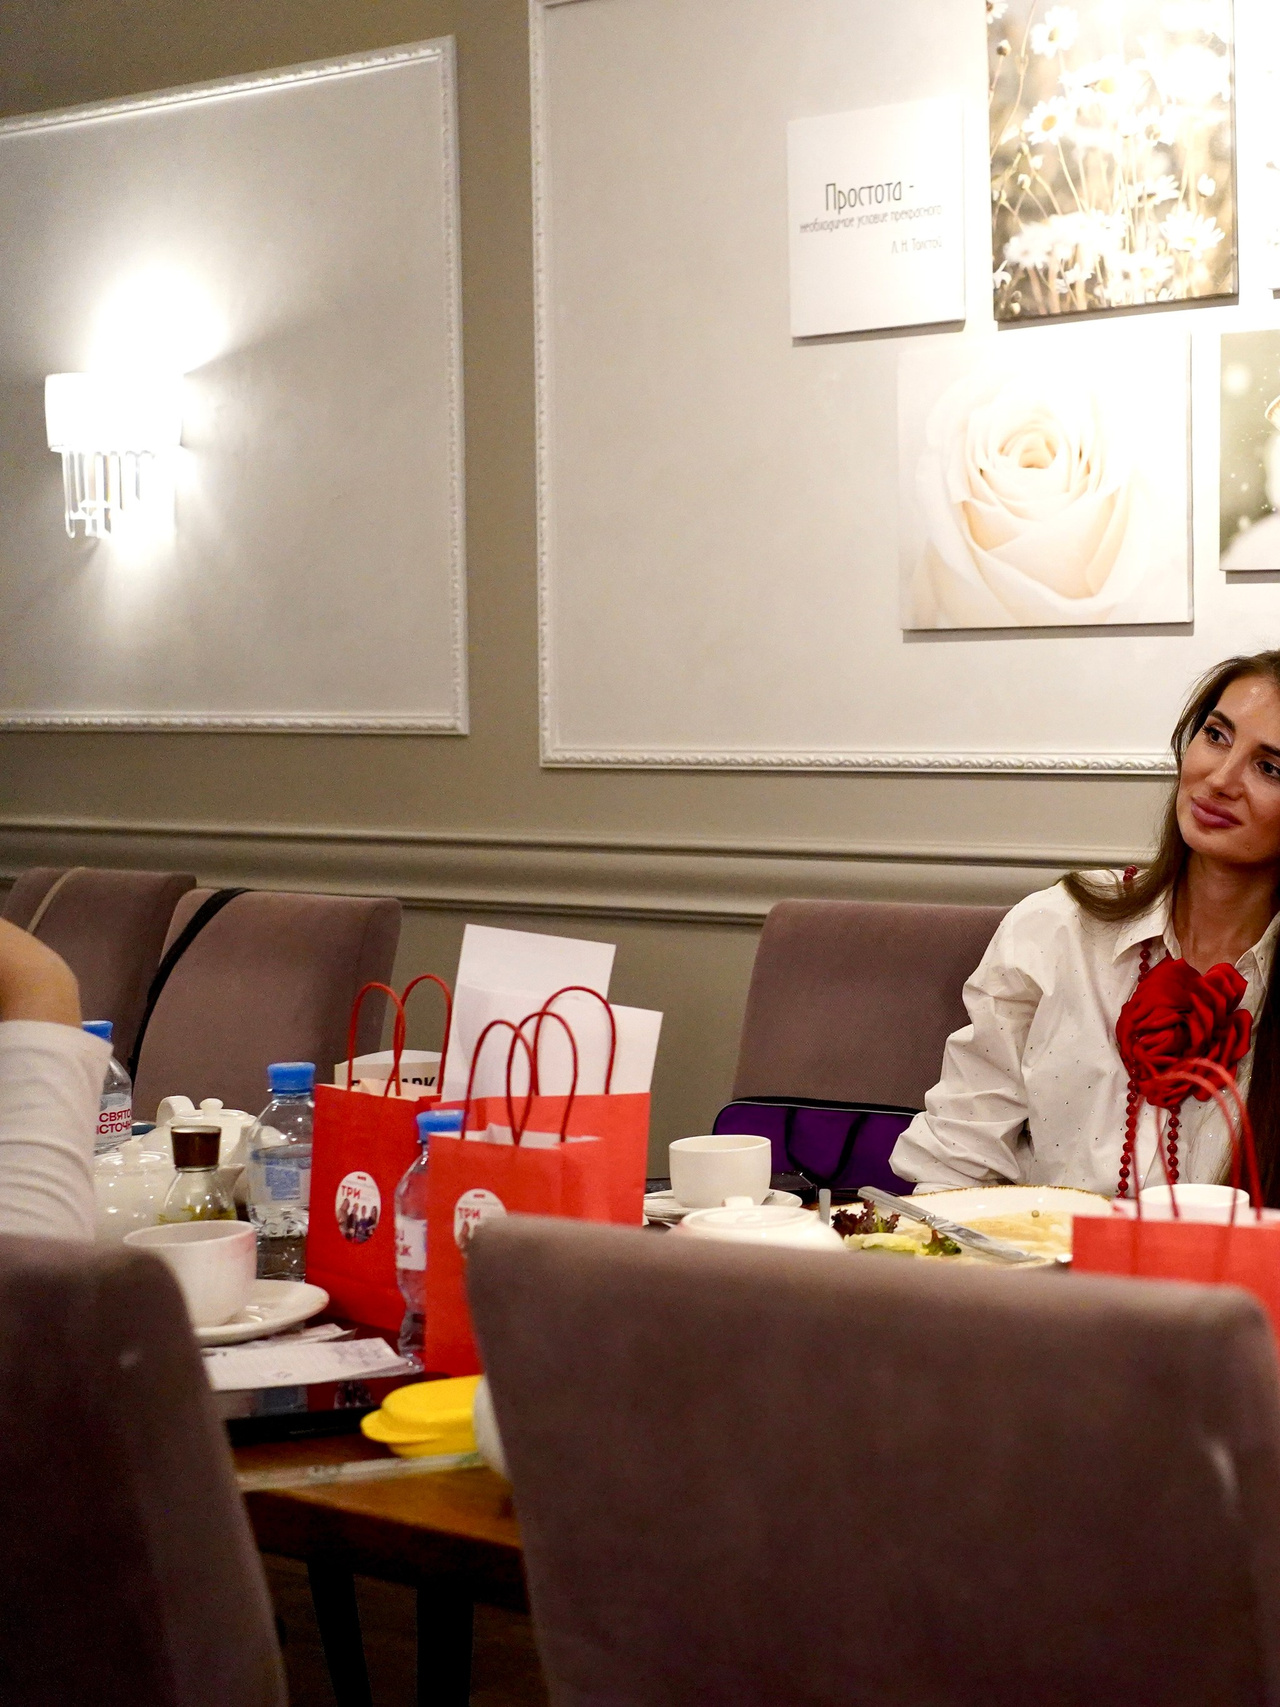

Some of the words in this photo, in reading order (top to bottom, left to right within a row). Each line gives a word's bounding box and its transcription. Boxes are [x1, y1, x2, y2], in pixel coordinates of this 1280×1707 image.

[825, 181, 902, 215] Простота
[341, 1185, 361, 1199] ТРИ
[458, 1206, 481, 1220] ТРИ
